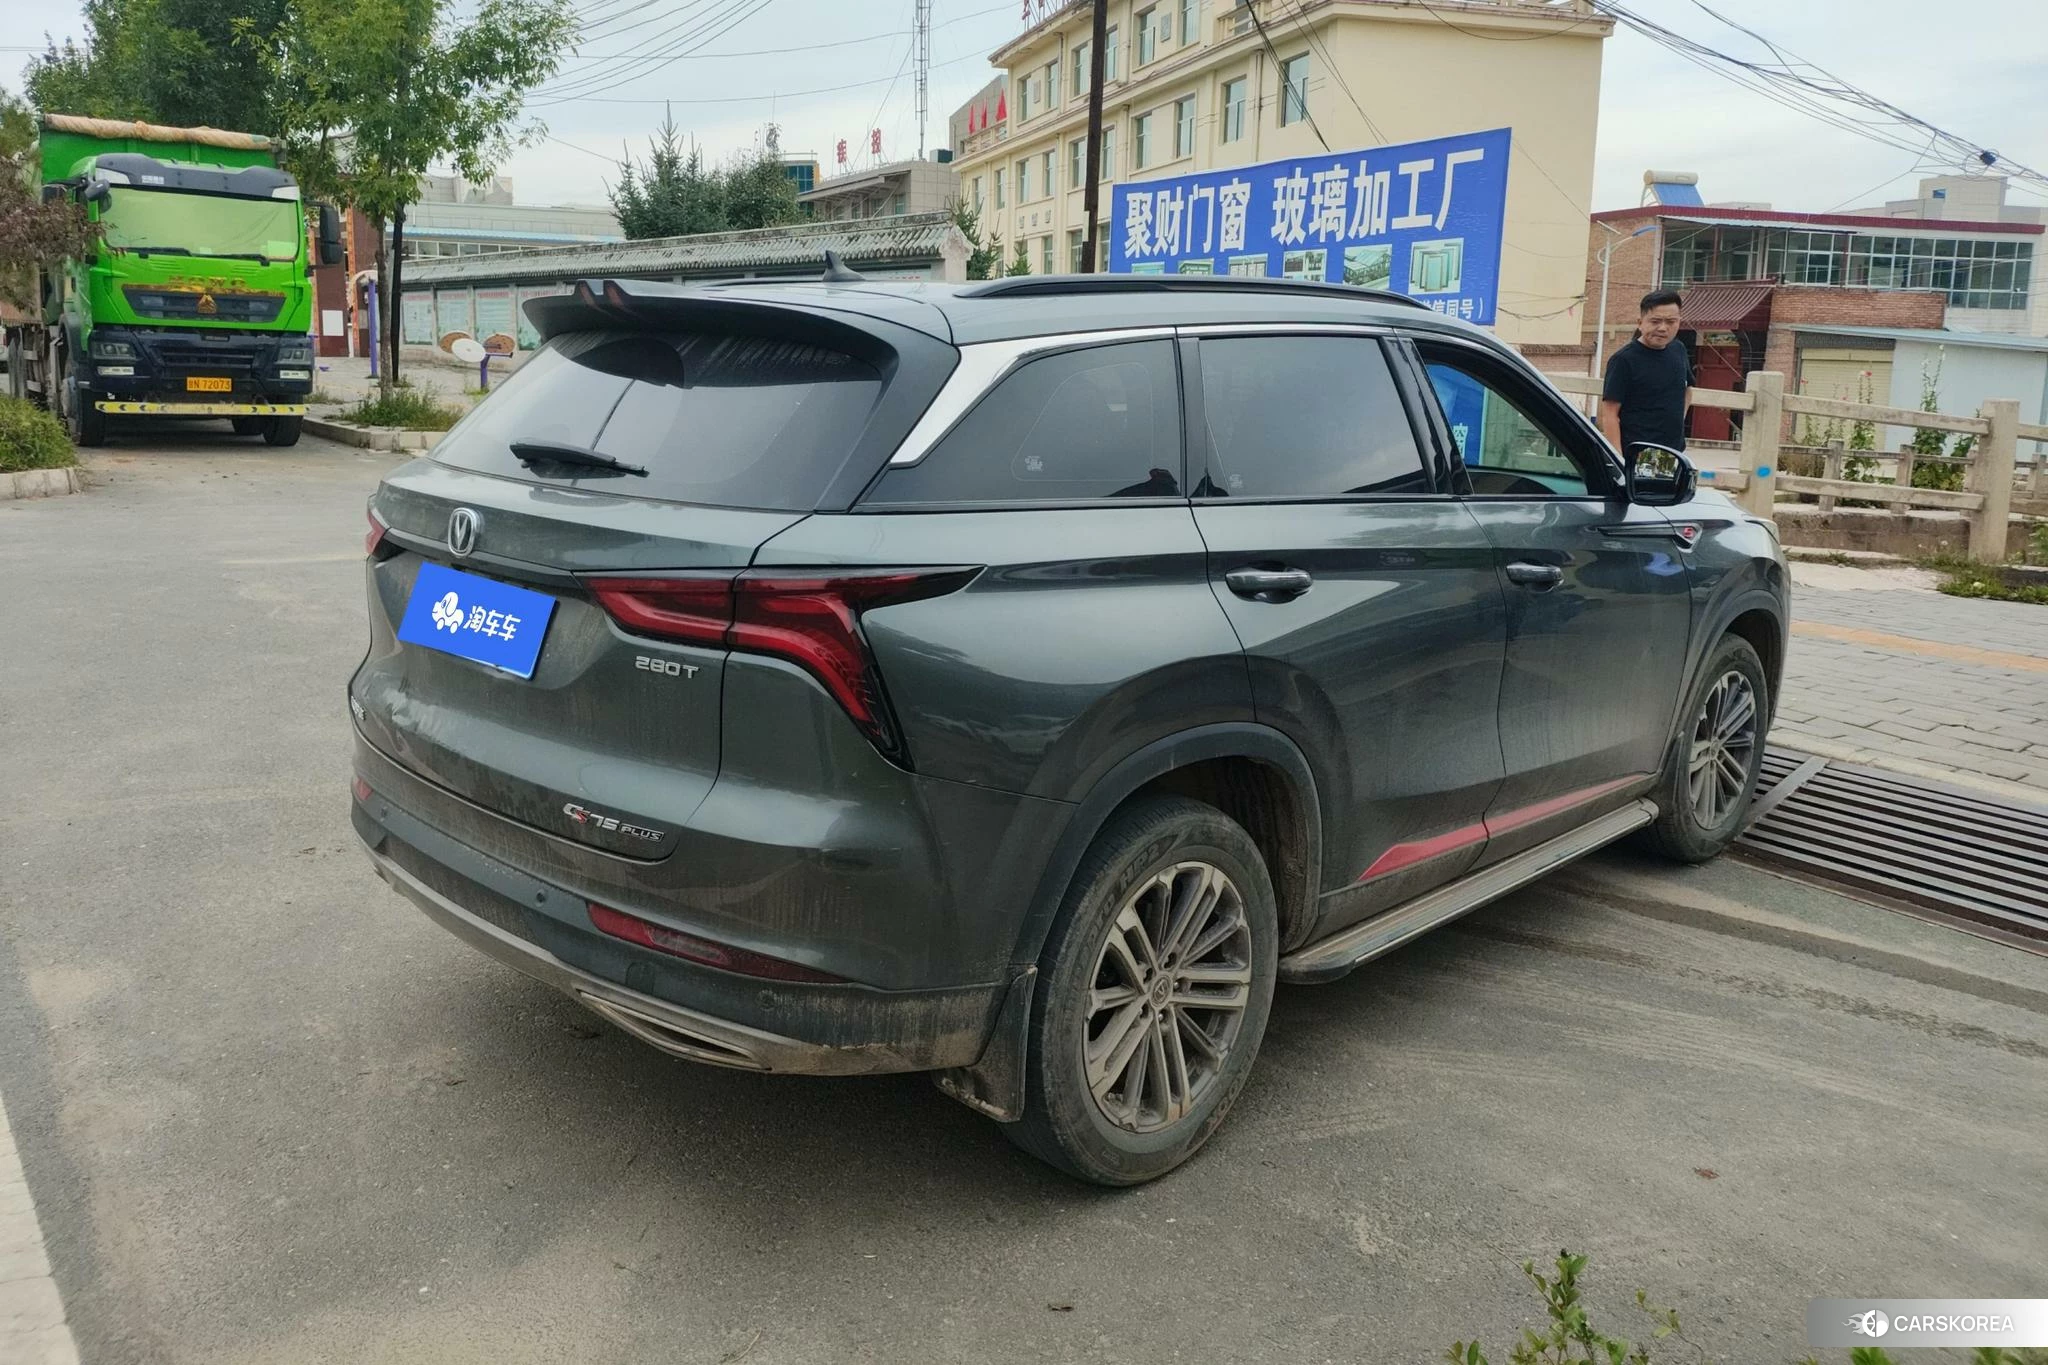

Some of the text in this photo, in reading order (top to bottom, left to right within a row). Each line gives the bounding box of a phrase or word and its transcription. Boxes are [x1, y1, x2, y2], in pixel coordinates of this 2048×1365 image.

[1124, 148, 1484, 258] 聚财门窗 玻璃加工厂
[202, 379, 230, 390] 72073
[635, 655, 699, 679] 280T
[620, 824, 663, 841] PLUS
